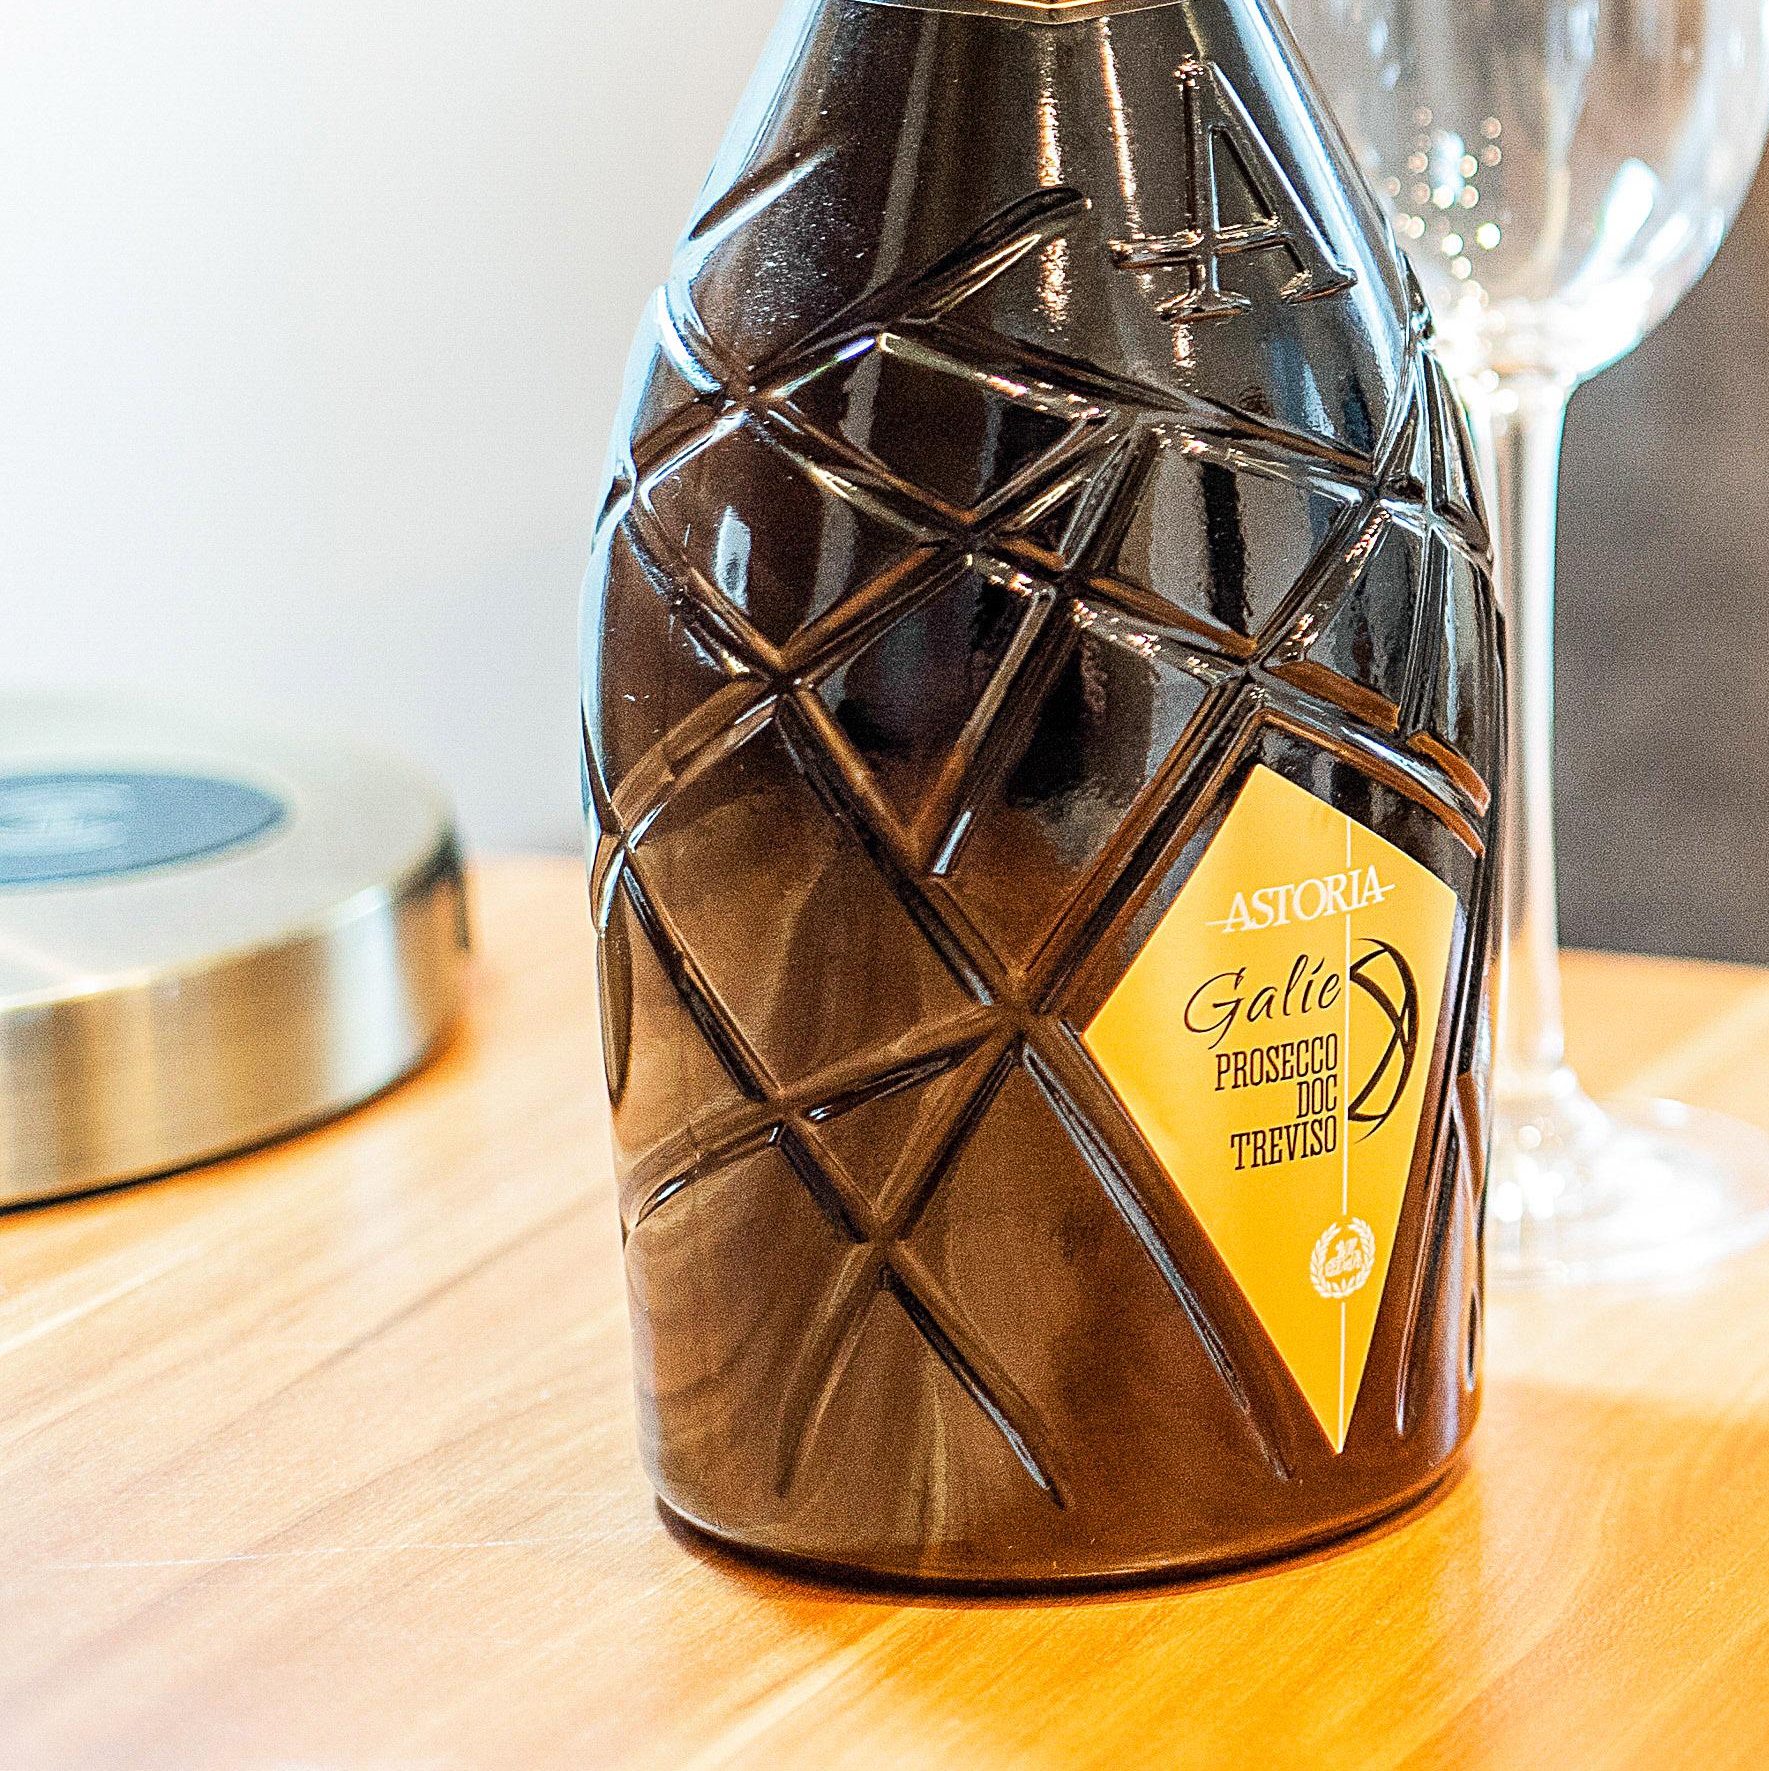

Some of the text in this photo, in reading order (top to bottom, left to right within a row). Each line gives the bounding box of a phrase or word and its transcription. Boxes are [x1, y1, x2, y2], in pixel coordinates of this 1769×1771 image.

[1205, 864, 1396, 933] ASTORIA
[1214, 1032, 1338, 1091] PROSECCO
[1296, 1074, 1338, 1119] DOC
[1230, 1115, 1337, 1171] TREVISO
